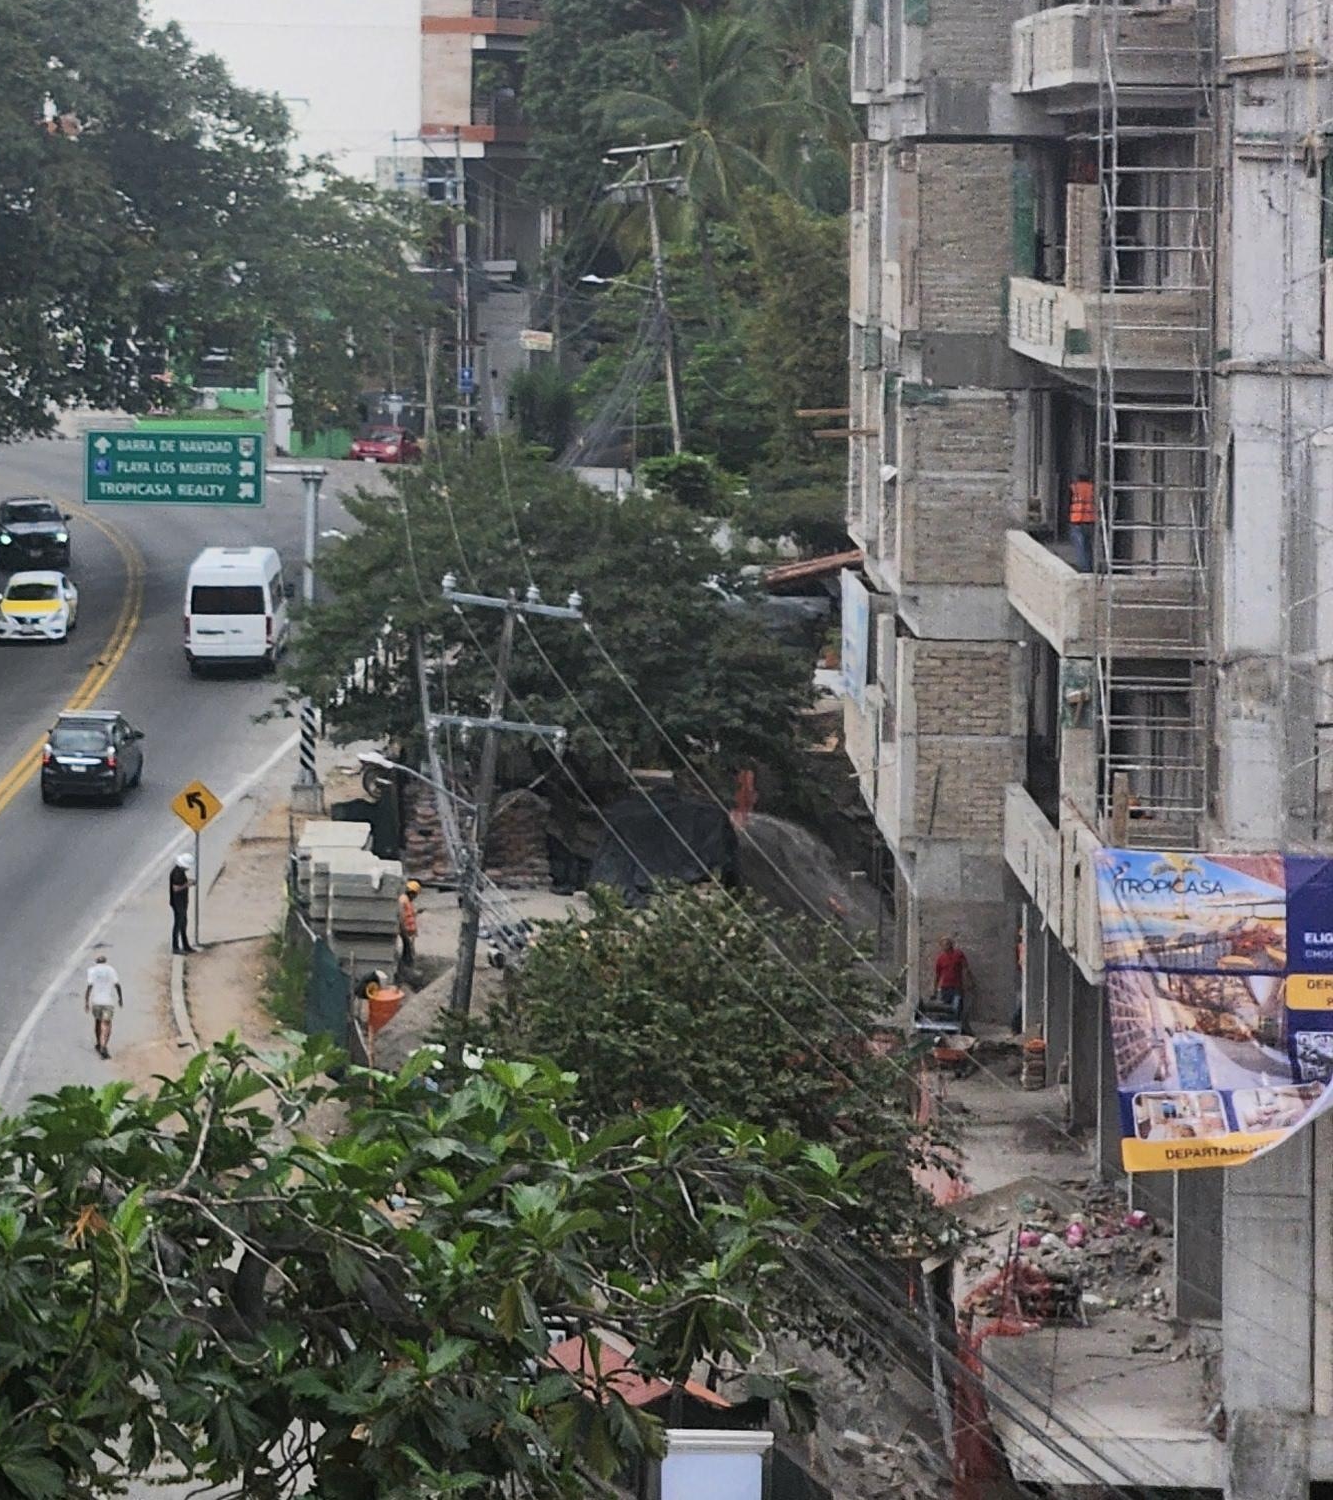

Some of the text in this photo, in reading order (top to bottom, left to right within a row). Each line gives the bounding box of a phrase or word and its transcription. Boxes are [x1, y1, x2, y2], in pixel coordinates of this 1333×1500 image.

[116, 439, 156, 452] BARRA
[159, 440, 175, 452] DE
[179, 440, 233, 453] NAVIDAD
[116, 460, 233, 475] PLAYA LOS MUERTOS
[99, 482, 226, 496] TROPICASA REALTY
[1117, 878, 1226, 897] TROPICASA
